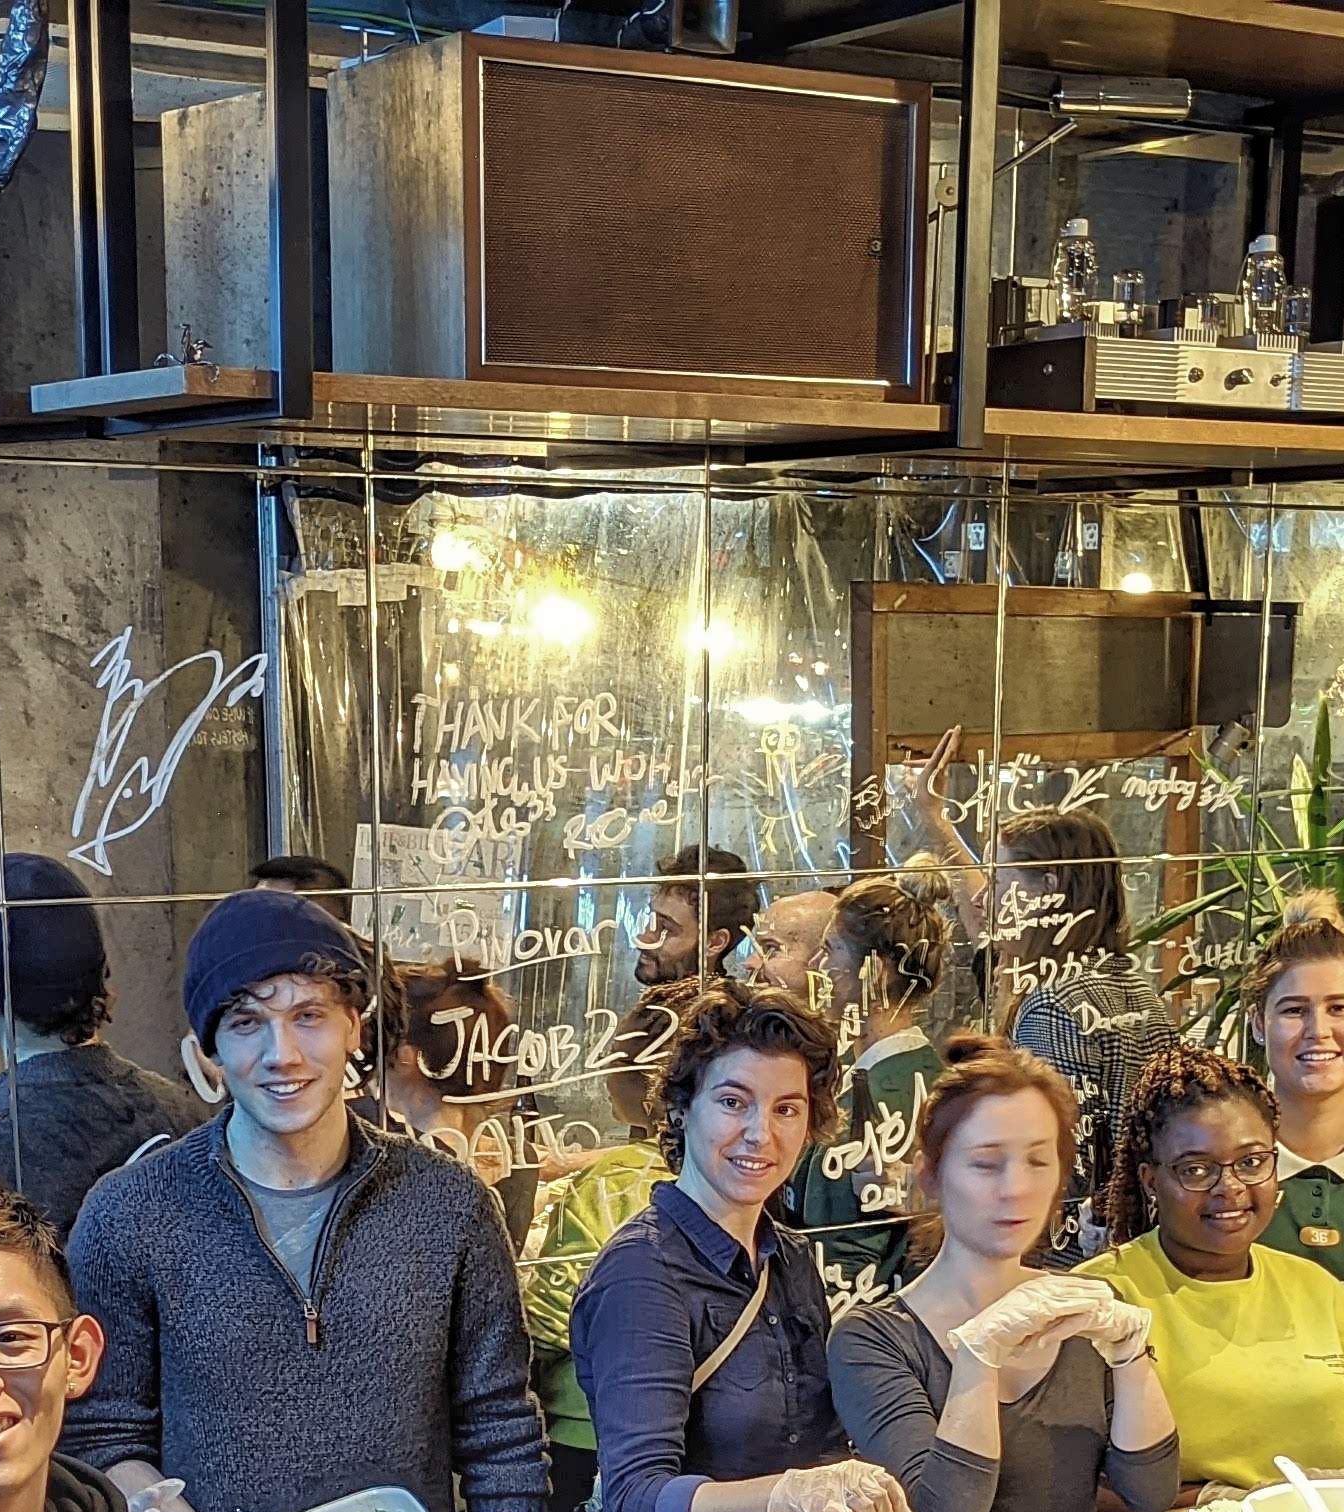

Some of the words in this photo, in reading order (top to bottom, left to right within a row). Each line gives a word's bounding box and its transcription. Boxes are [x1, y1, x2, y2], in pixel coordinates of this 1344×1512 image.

[411, 692, 542, 754] THANK
[551, 692, 621, 751] FOR
[1311, 1231, 1329, 1244] 36
